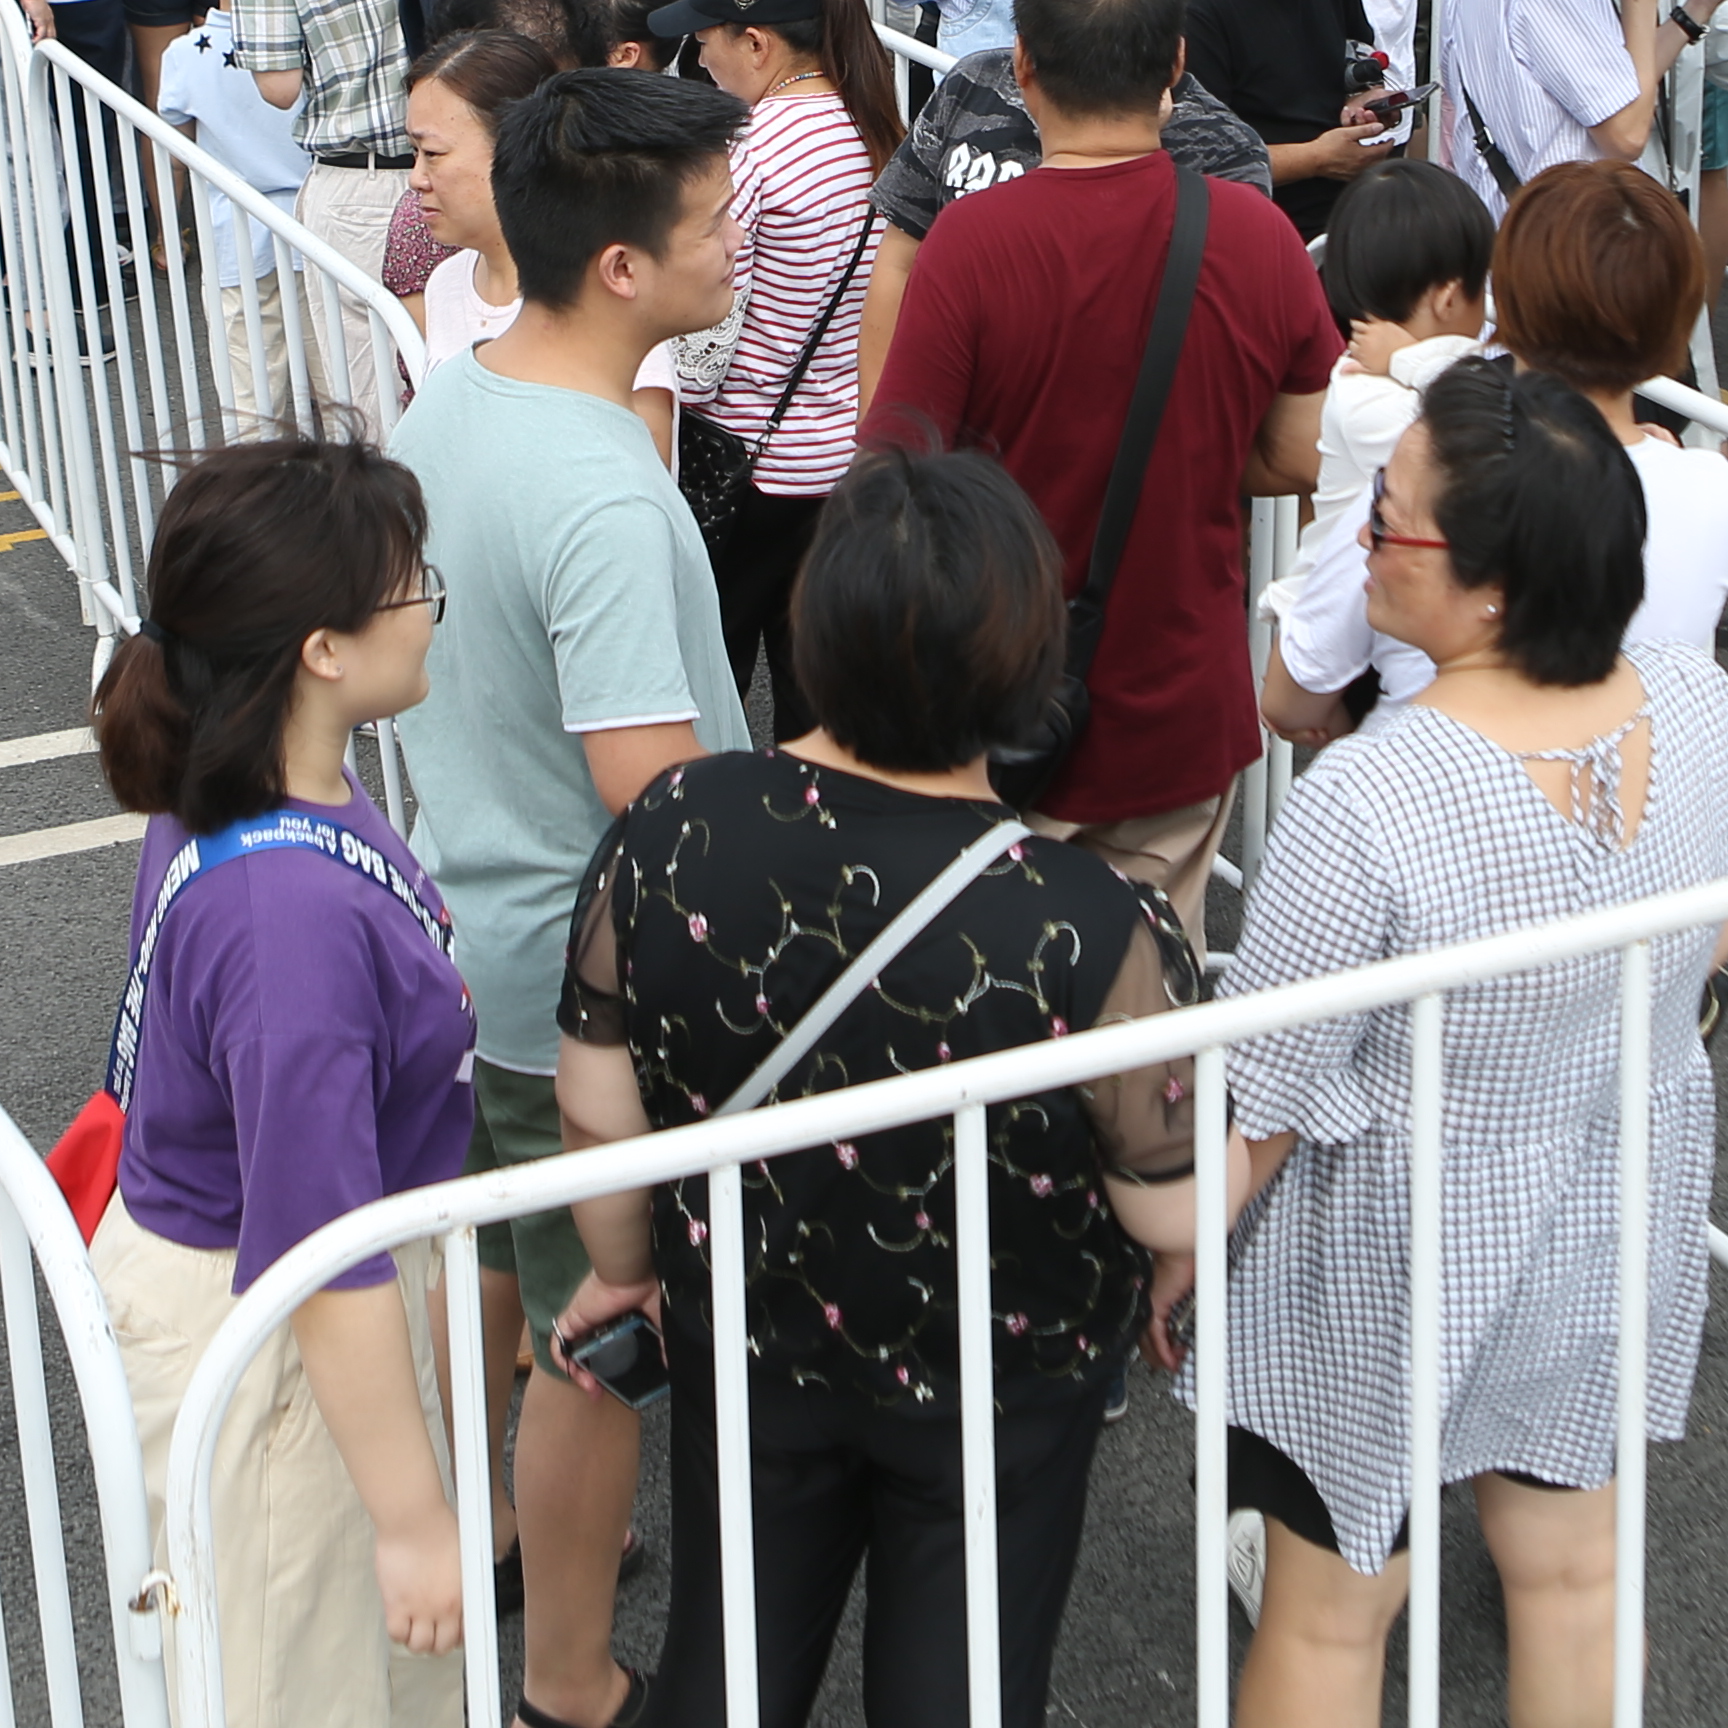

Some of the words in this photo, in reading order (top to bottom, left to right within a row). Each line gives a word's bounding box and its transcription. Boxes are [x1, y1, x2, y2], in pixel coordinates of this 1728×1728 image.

[240, 828, 325, 852] backpack
[279, 816, 312, 831] you
[157, 838, 201, 923] MENG
[340, 831, 387, 885] BAG
[116, 1010, 138, 1070] BAG
